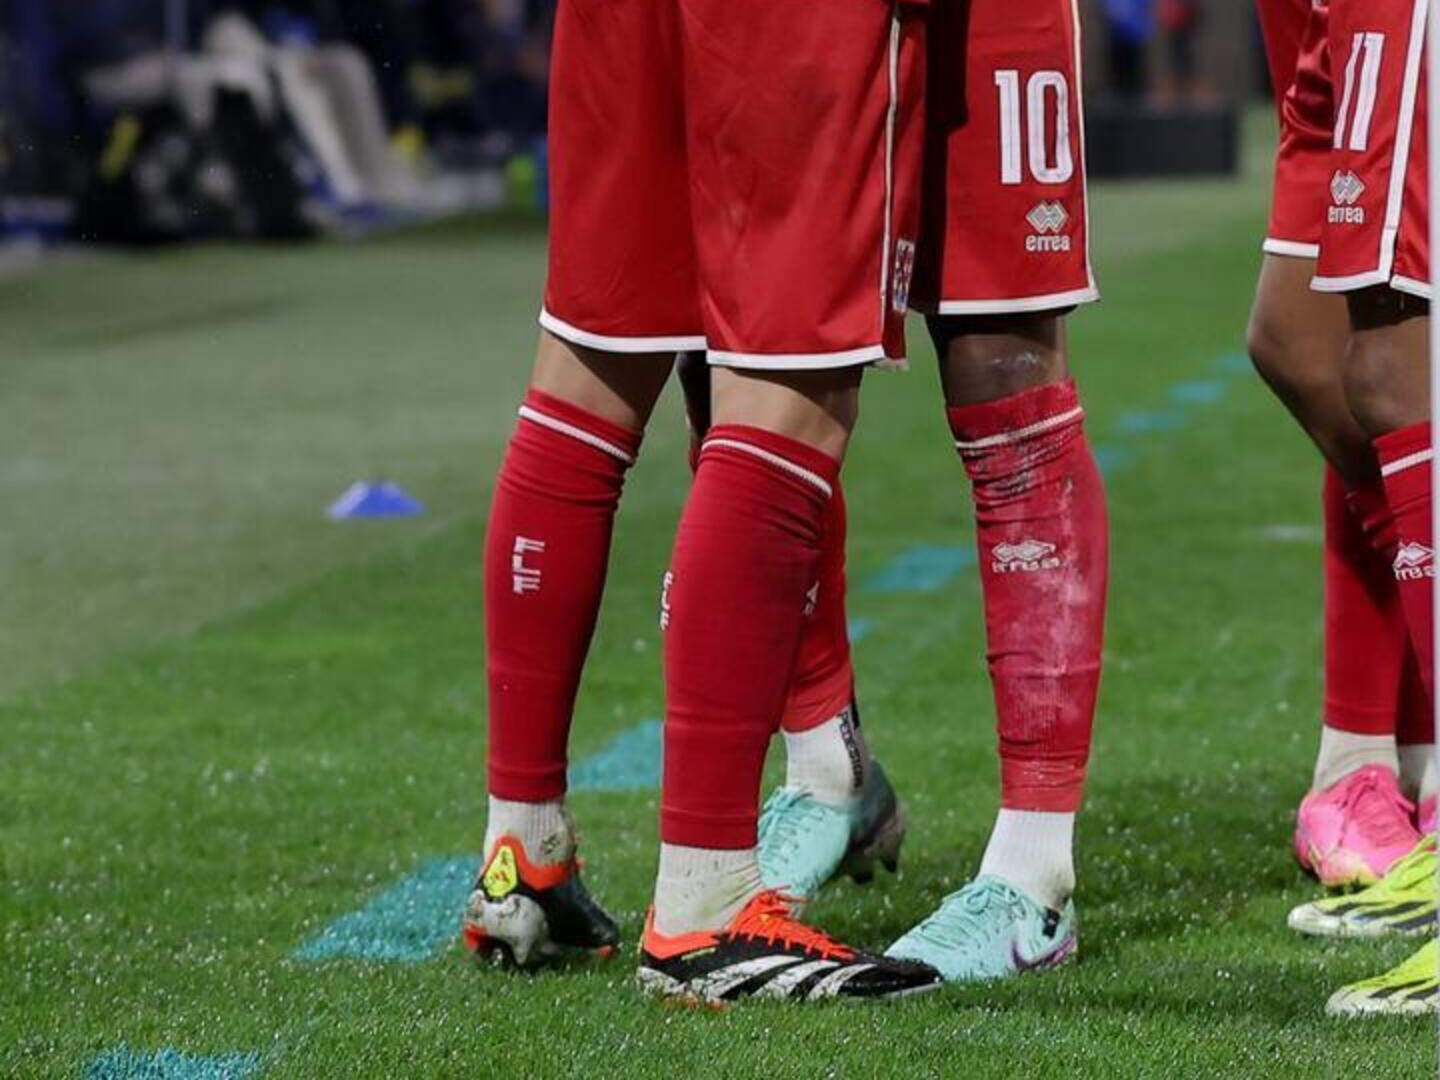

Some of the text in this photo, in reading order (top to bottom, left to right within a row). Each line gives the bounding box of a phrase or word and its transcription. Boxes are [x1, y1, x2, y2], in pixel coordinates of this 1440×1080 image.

[1333, 31, 1385, 152] 11
[993, 69, 1074, 185] 10
[1025, 234, 1071, 252] errea
[1327, 205, 1365, 224] errea
[512, 535, 546, 595] FLF
